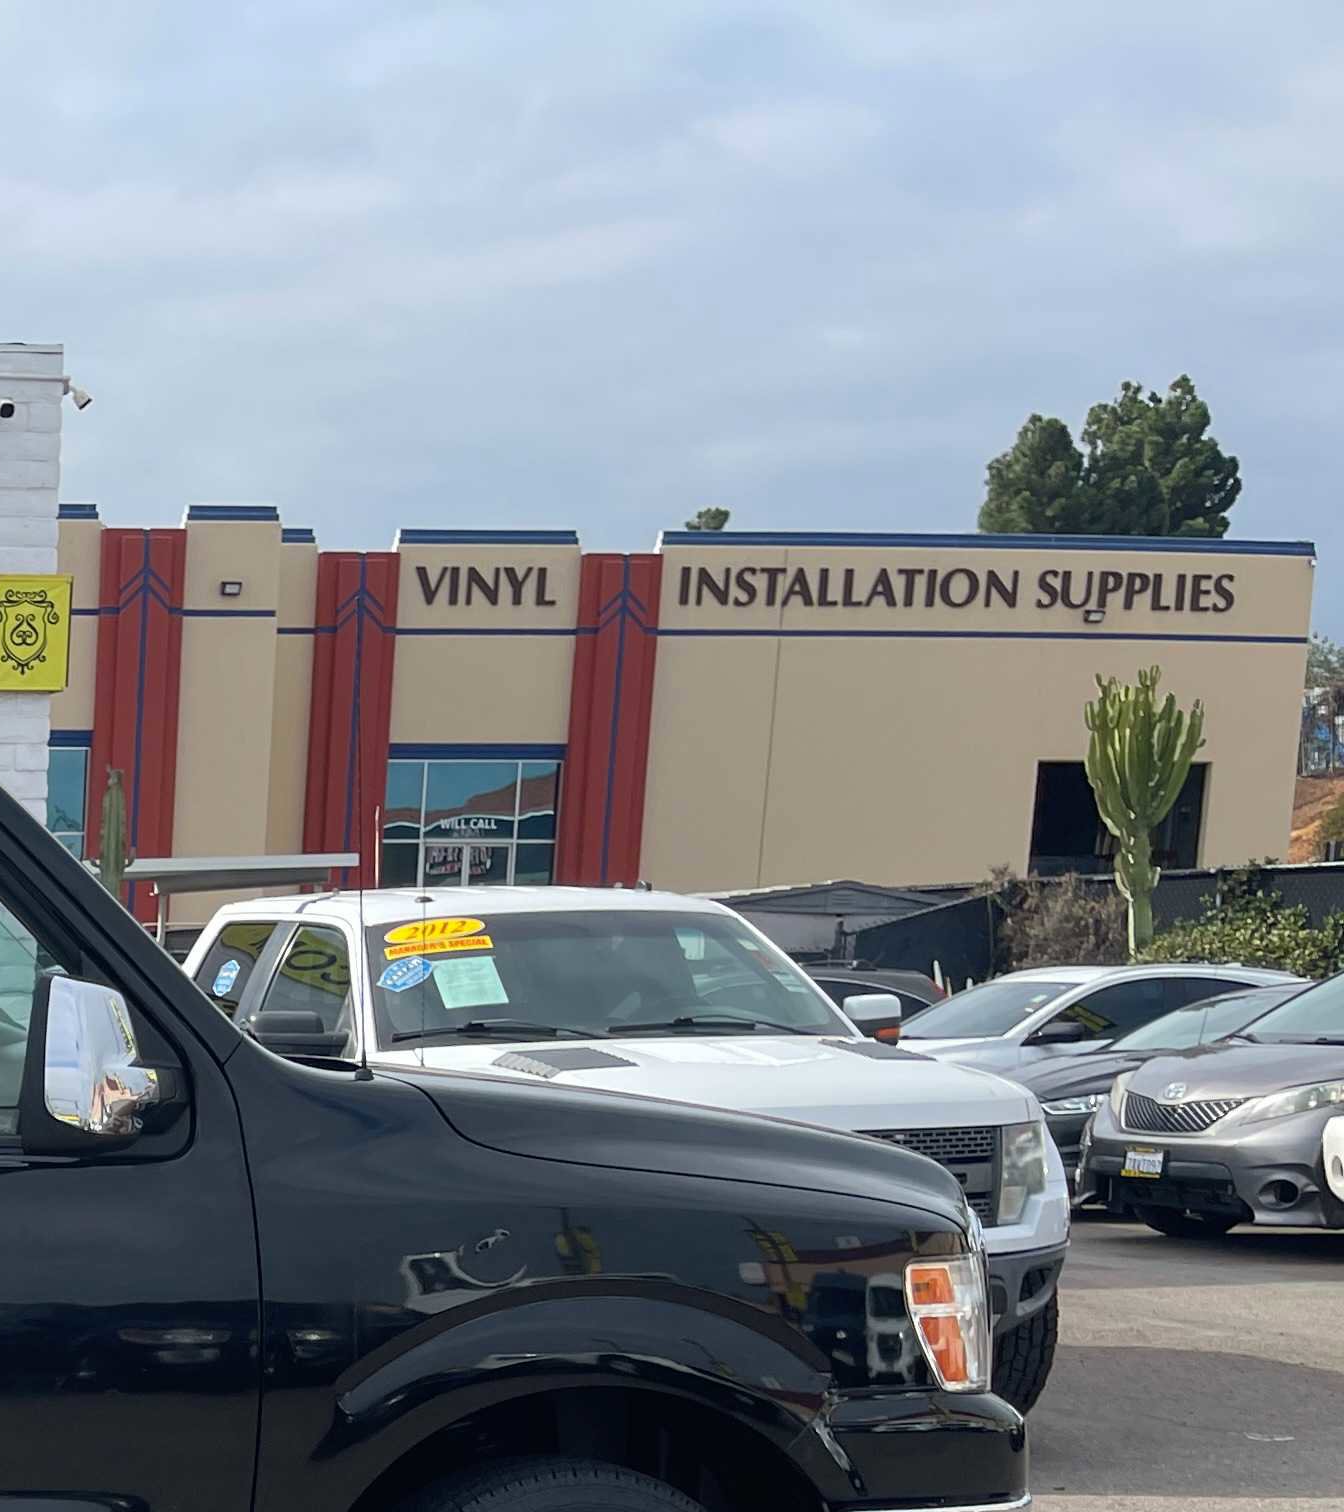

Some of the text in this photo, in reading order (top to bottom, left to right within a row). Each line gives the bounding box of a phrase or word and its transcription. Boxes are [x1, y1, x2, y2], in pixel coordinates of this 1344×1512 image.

[415, 565, 557, 608] VINYL
[678, 564, 1238, 614] INSTALLATION SUPPLIES
[440, 818, 498, 830] WILL CALL
[405, 920, 467, 940] 2012
[448, 938, 488, 949] SPECIAL
